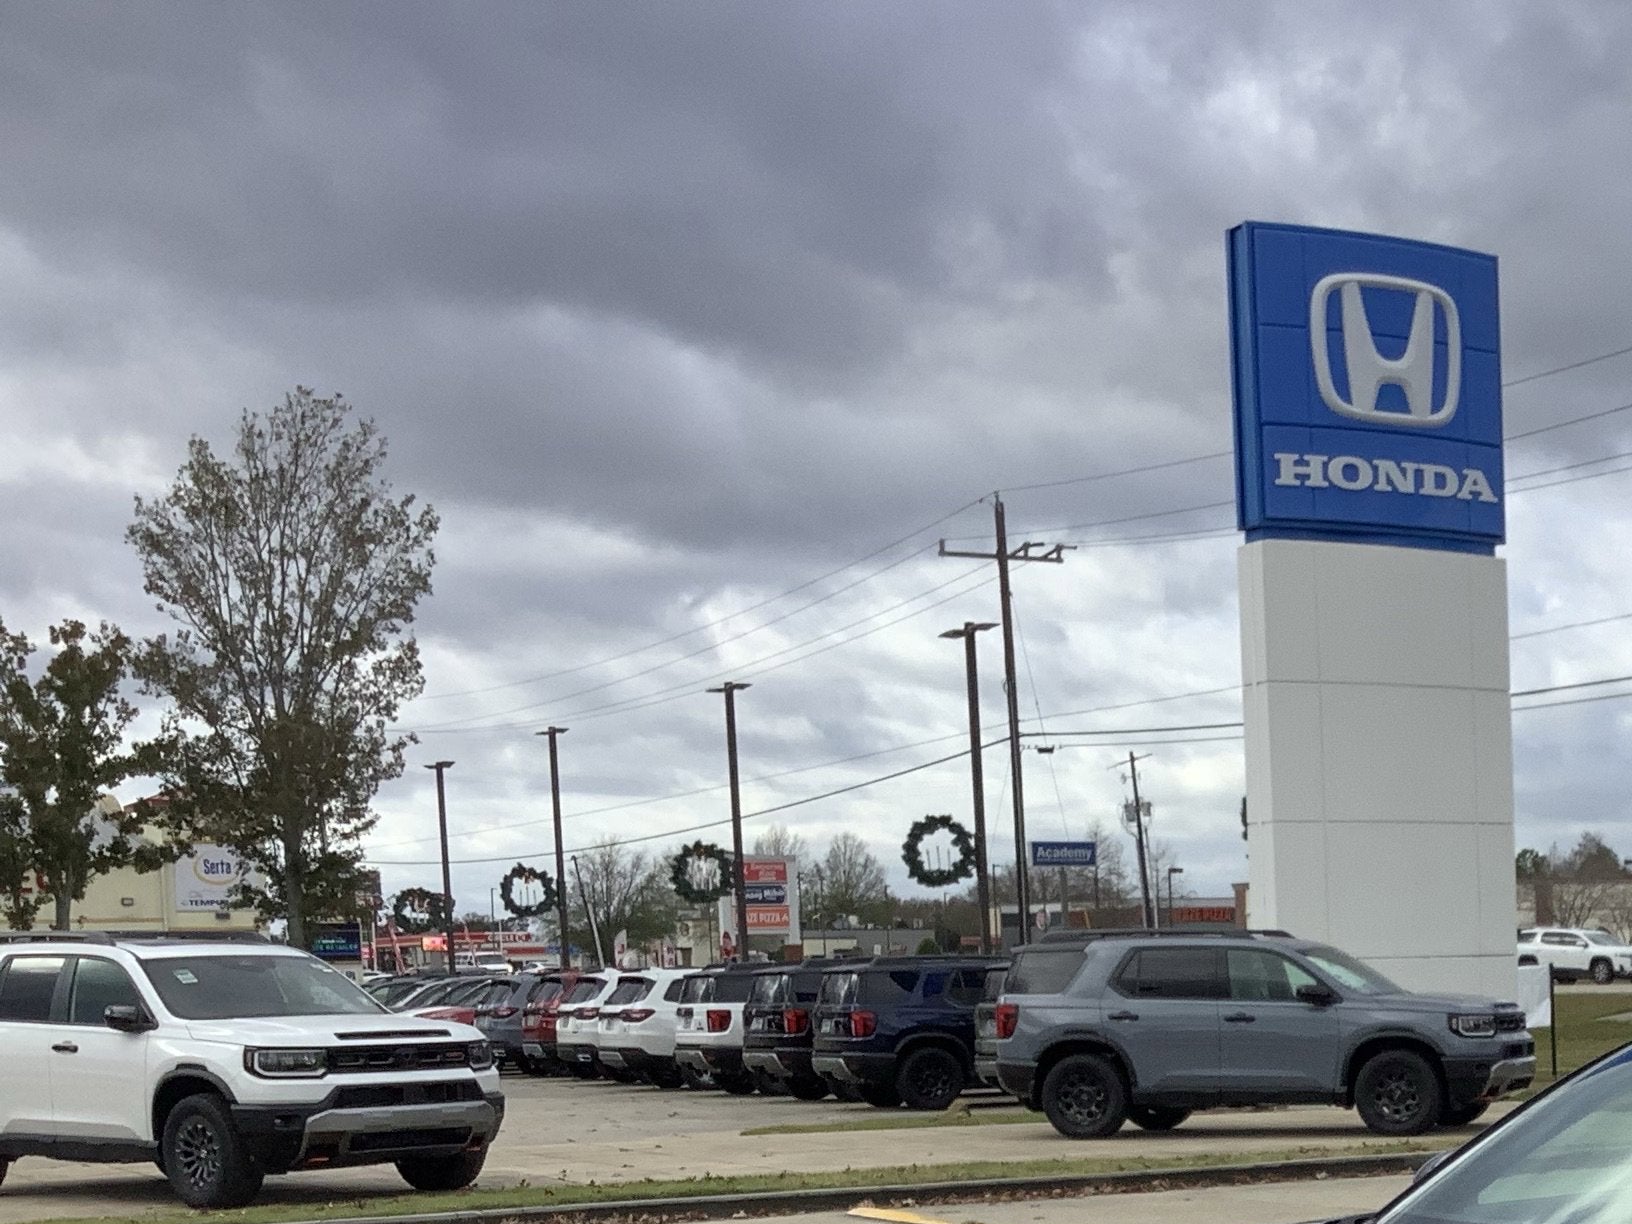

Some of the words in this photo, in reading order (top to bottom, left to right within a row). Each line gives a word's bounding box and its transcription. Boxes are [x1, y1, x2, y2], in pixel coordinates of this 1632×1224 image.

[1274, 452, 1499, 504] HONDA
[1036, 846, 1092, 861] Academy
[203, 858, 232, 875] Serta
